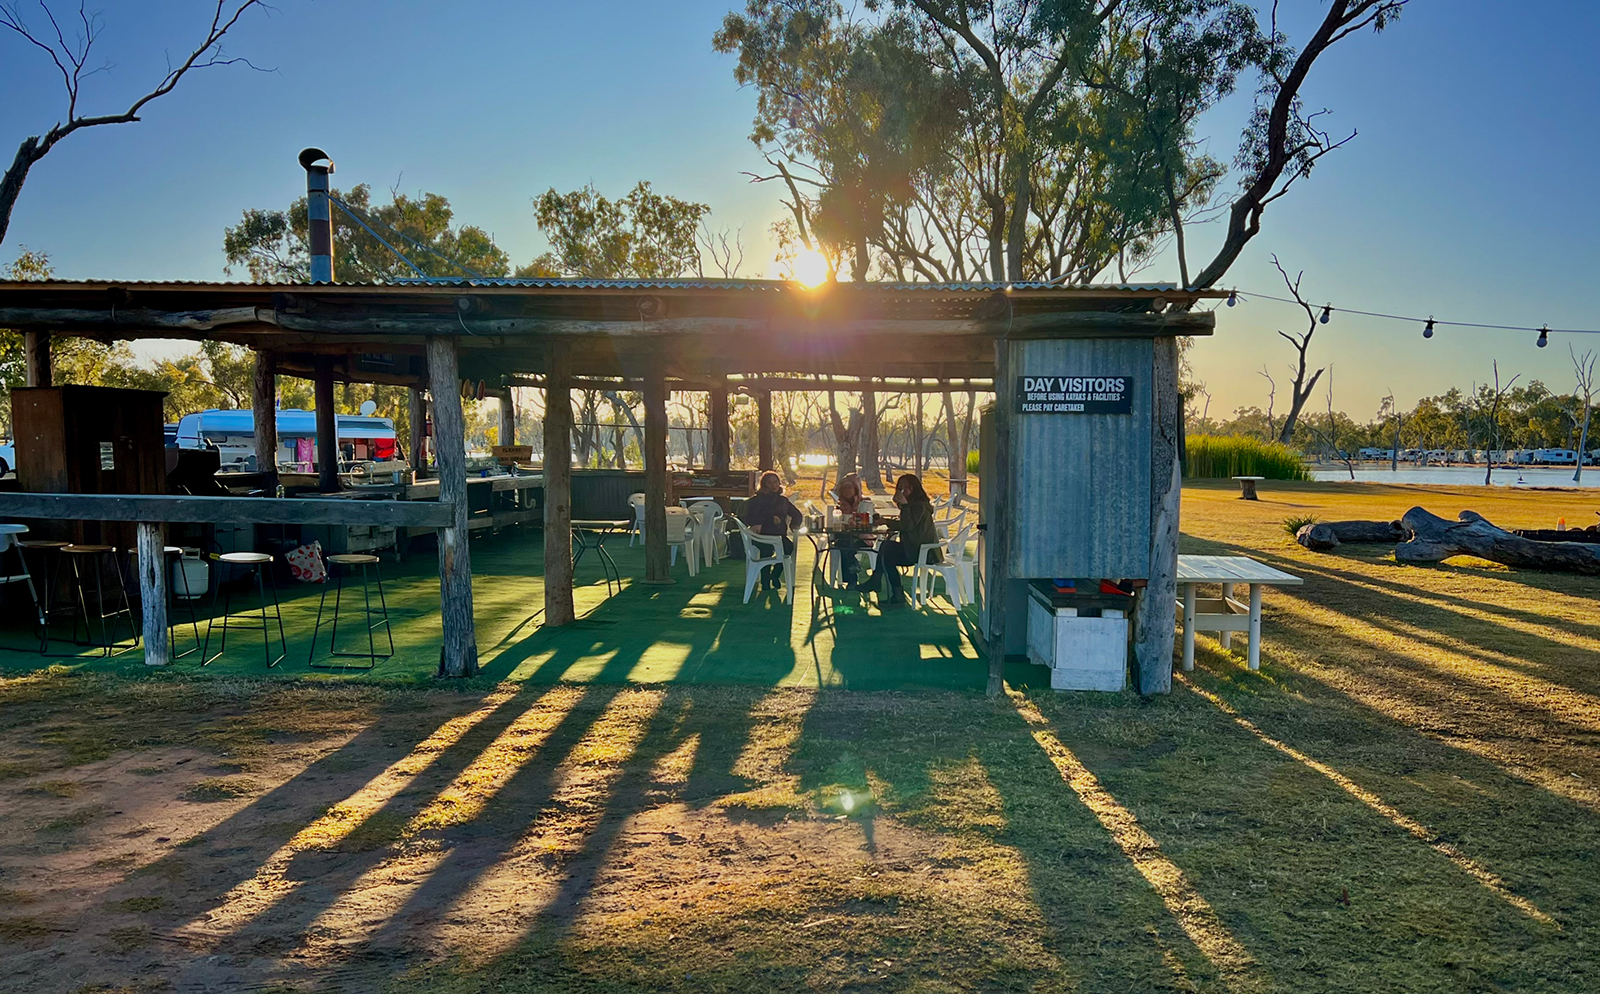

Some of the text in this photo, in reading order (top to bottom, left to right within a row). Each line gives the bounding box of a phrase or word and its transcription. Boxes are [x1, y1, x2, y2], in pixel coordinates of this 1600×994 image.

[1024, 378, 1125, 392] DAY VISITORS
[1027, 393, 1047, 401] BEFORE
[1048, 393, 1065, 401] USING
[1066, 393, 1086, 401] KAYAKS
[1093, 393, 1120, 401] FACILITIES
